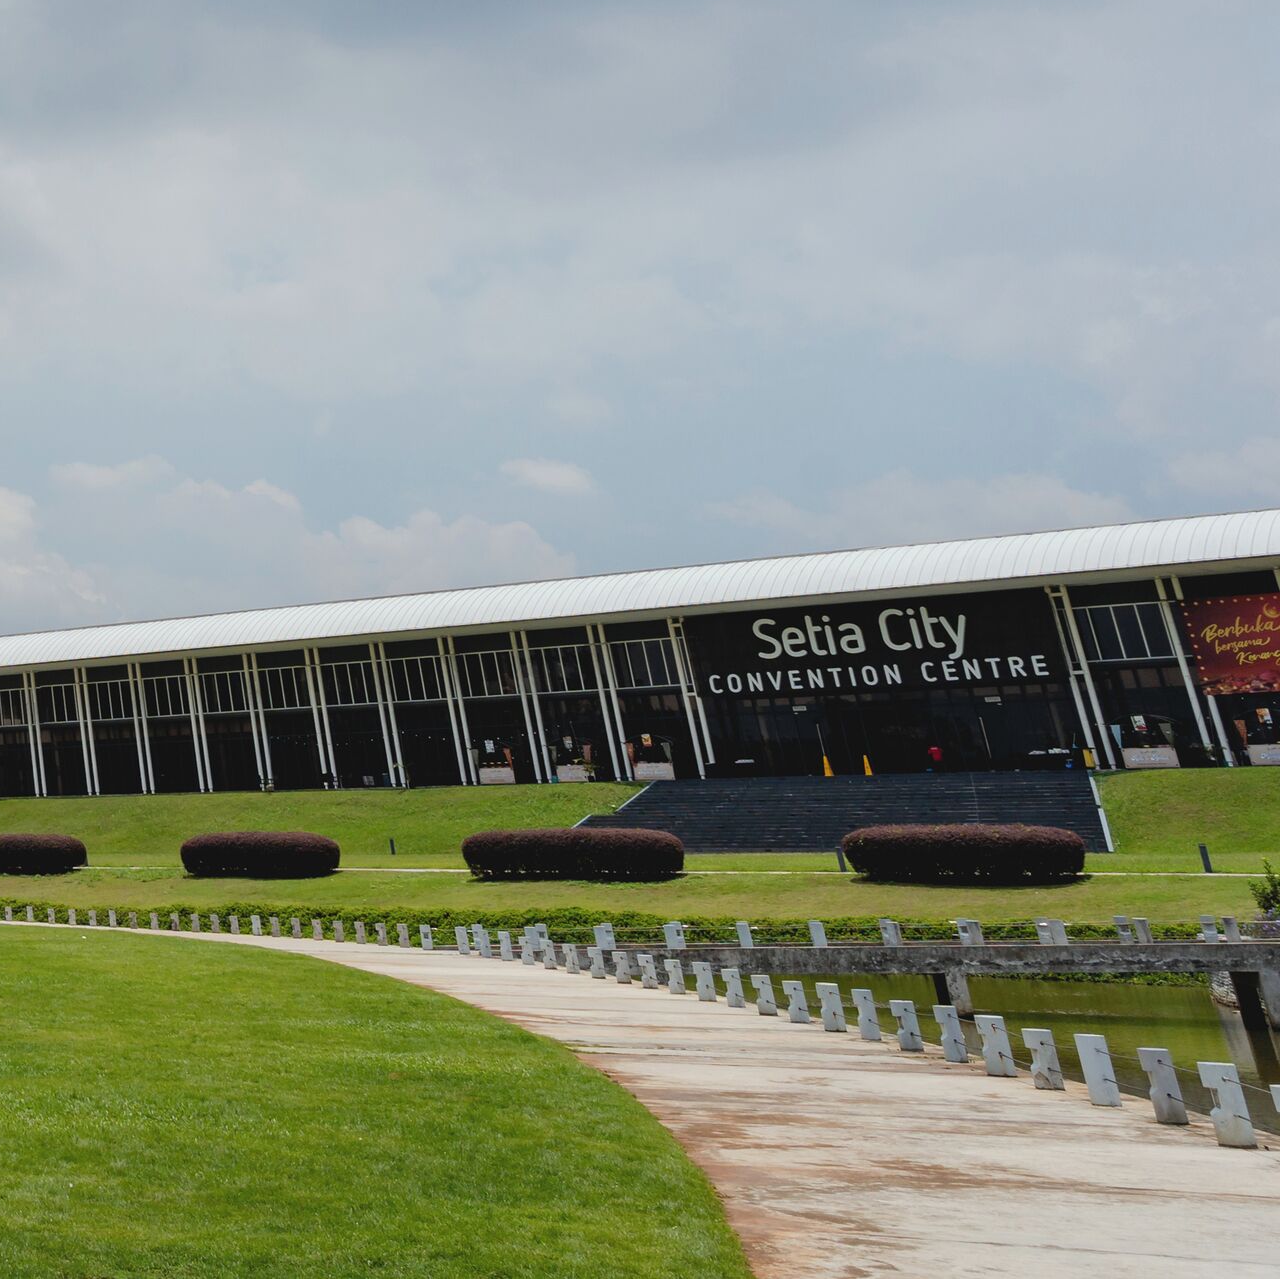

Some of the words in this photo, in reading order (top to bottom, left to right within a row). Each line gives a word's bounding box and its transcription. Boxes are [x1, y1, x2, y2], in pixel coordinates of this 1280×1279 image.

[752, 615, 867, 660] Setia
[878, 606, 966, 659] City
[1201, 614, 1280, 643] Berbuka
[1215, 637, 1271, 654] bersama
[708, 664, 902, 694] CONVENTION
[921, 655, 1050, 683] CENTRE
